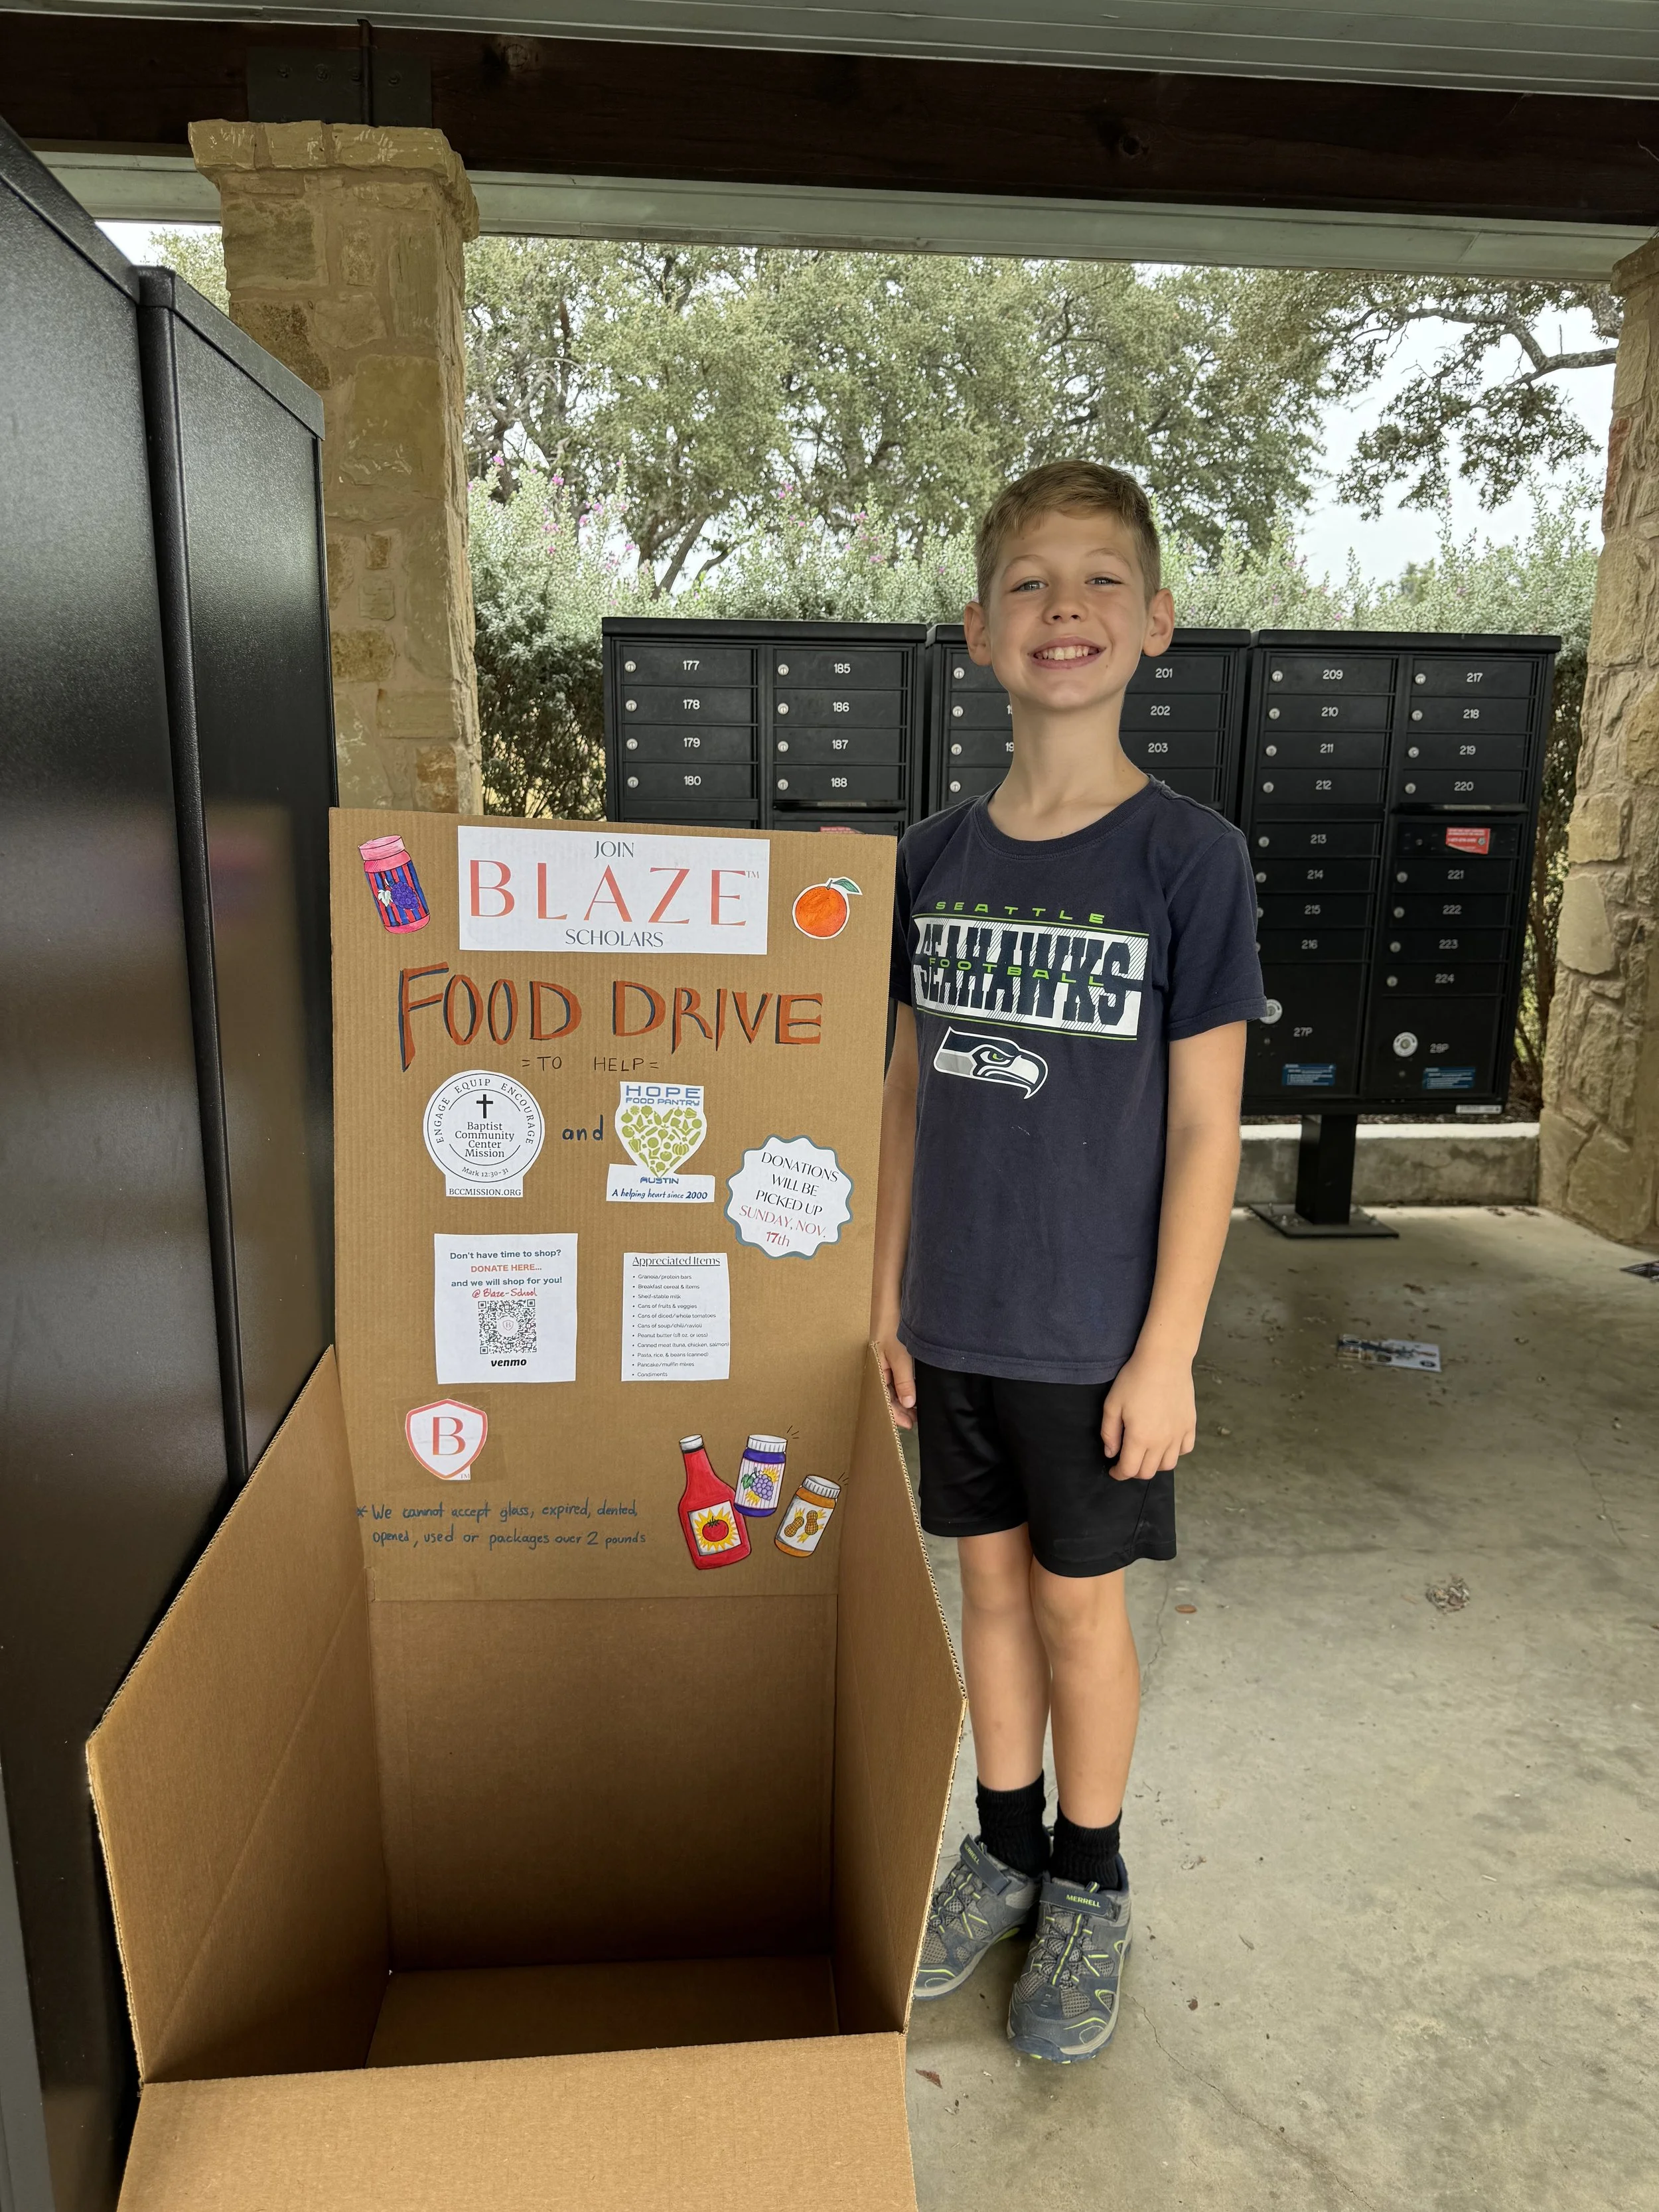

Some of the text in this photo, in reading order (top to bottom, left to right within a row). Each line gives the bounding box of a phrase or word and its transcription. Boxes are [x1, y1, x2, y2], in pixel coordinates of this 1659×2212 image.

[683, 660, 700, 671] 177
[833, 663, 851, 674] 185
[1155, 668, 1173, 678] 201
[1323, 669, 1343, 680] 209
[1466, 672, 1483, 683] 217
[683, 699, 700, 710] 178
[832, 701, 850, 712] 186
[1150, 705, 1171, 716] 202
[1321, 706, 1338, 717] 210
[1463, 709, 1480, 719] 218
[684, 737, 701, 748] 179
[832, 739, 849, 750] 187
[1147, 743, 1169, 753] 203
[1320, 743, 1334, 753] 211
[1459, 745, 1477, 755] 219
[684, 775, 701, 786] 180
[831, 777, 848, 788] 188
[1315, 780, 1332, 790] 212
[1454, 781, 1474, 791] 220
[1310, 834, 1327, 844] 213
[594, 840, 634, 859] JOIN
[1307, 869, 1323, 880] 214
[1447, 869, 1465, 880] 221
[470, 859, 747, 926] BLAZE
[935, 901, 1105, 924] SEATTLE
[1304, 905, 1321, 915] 215
[1442, 905, 1462, 915] 222
[565, 929, 664, 948] SCHOLARS
[1301, 939, 1318, 950] 216
[1439, 939, 1458, 950] 223
[930, 958, 1104, 987] FOOTBALL
[1435, 974, 1455, 984] 224
[399, 961, 823, 1071] FOOD DRIVE
[1293, 1027, 1313, 1037] 27P
[626, 1085, 701, 1099] HOPE
[434, 1078, 536, 1144] ENGAGE EQUIP ENCOURAGE
[467, 1122, 503, 1132] Baptist
[561, 1114, 604, 1141] and
[455, 1131, 515, 1142] Community
[468, 1140, 502, 1149] Center
[465, 1149, 504, 1158] Mission
[462, 1167, 509, 1177] Mark 12:30-31
[761, 1151, 839, 1183] DONATIONS
[772, 1173, 820, 1197] WILL BE
[621, 1188, 645, 1199] helping
[648, 1188, 666, 1198] heart
[755, 1189, 823, 1216] PICKED UP
[739, 1205, 826, 1238] SUNDAY, NOV.
[766, 1231, 790, 1247] 17th
[450, 1251, 474, 1260] Don't
[534, 1249, 561, 1258] shop?
[632, 1256, 721, 1267] Appreciated Items
[470, 1264, 509, 1273] DONATE
[543, 1276, 562, 1285] you!
[490, 1359, 527, 1367] venmo
[431, 1416, 466, 1455] B
[403, 1501, 445, 1518] cannot
[451, 1499, 491, 1523] accept
[500, 1501, 535, 1522] glass,
[541, 1497, 591, 1518] expired,
[597, 1499, 638, 1517] dented,
[424, 1524, 455, 1544] used
[463, 1533, 479, 1542] or
[489, 1529, 550, 1551] packages
[555, 1534, 581, 1544] over
[587, 1531, 599, 1545] 2
[605, 1531, 646, 1550] pounds
[1066, 1894, 1102, 1908] MERRELL
